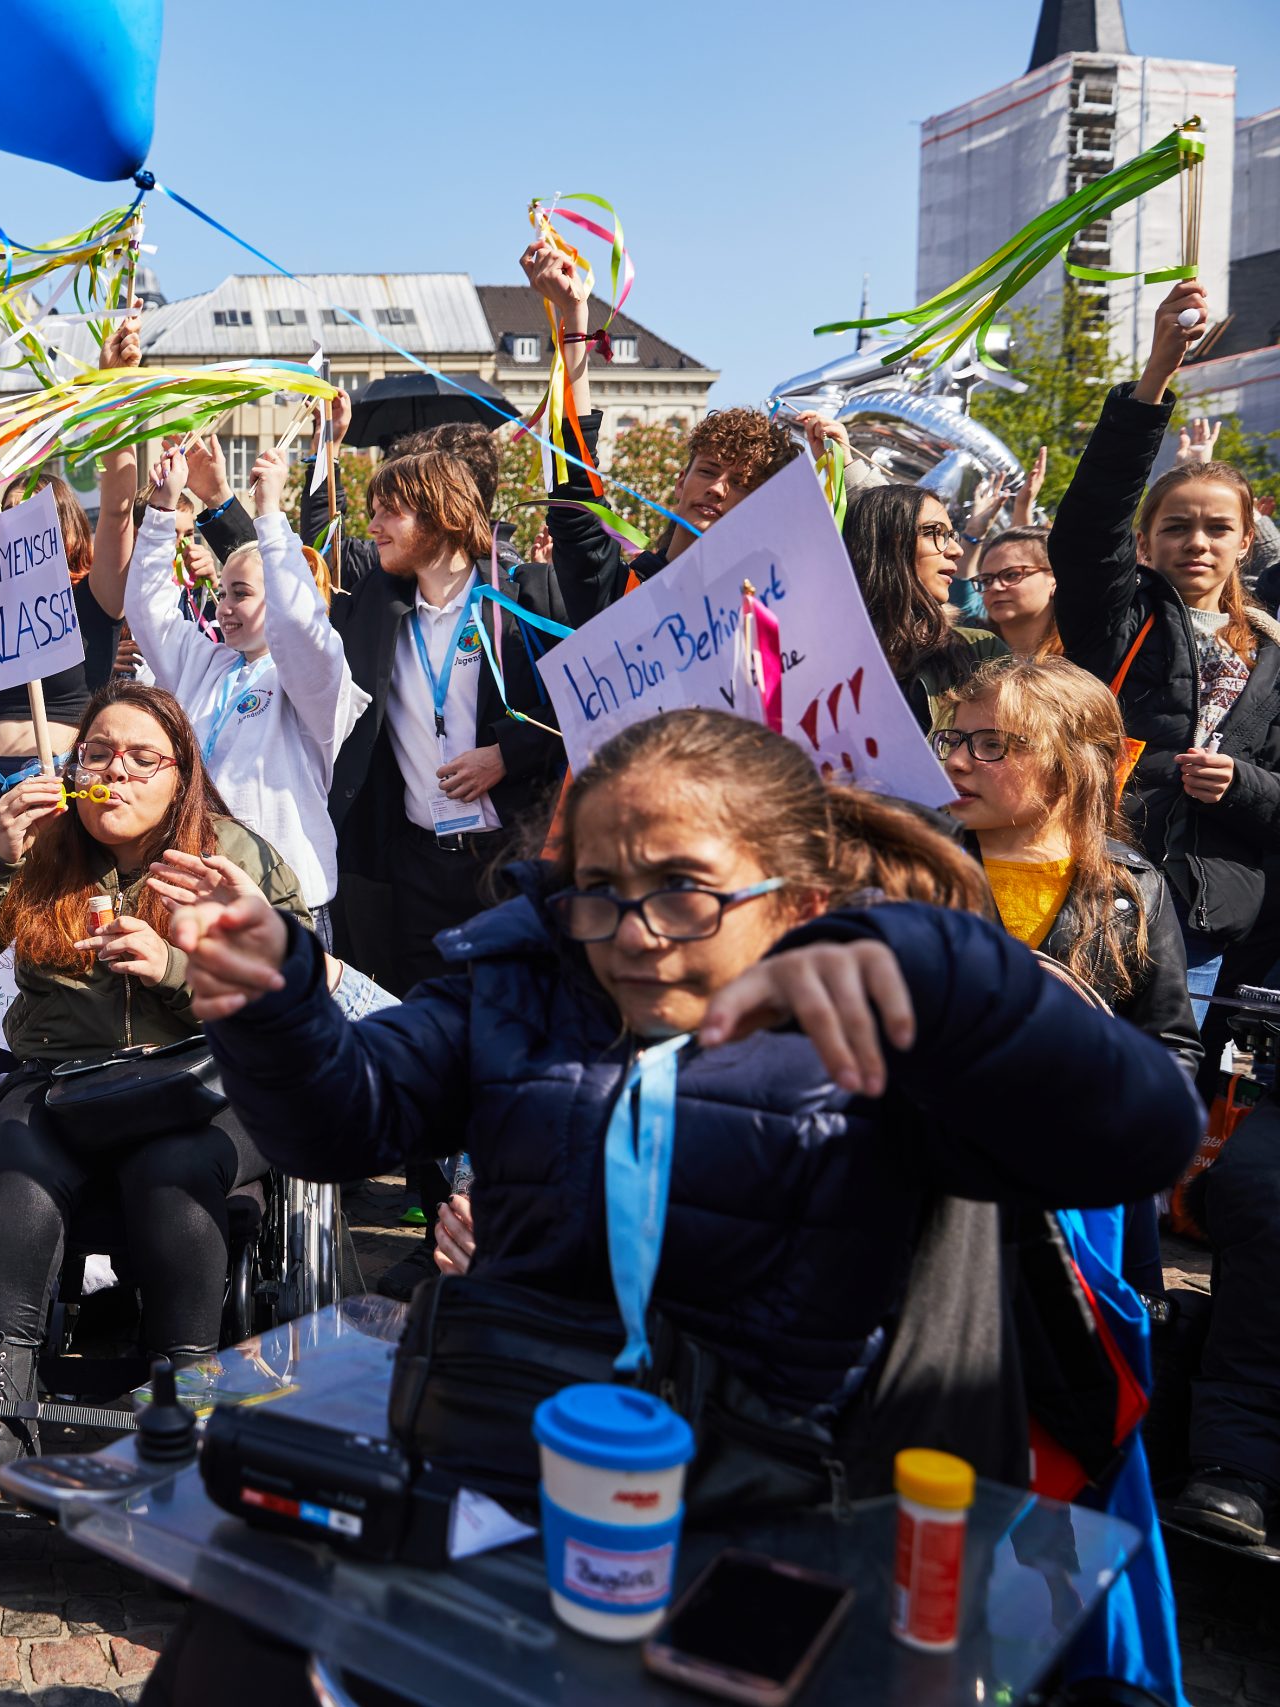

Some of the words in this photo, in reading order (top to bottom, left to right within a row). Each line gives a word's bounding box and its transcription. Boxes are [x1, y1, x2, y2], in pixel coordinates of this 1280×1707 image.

[563, 656, 619, 721] Ich
[614, 640, 664, 699] bin
[652, 563, 786, 673] Behinrt
